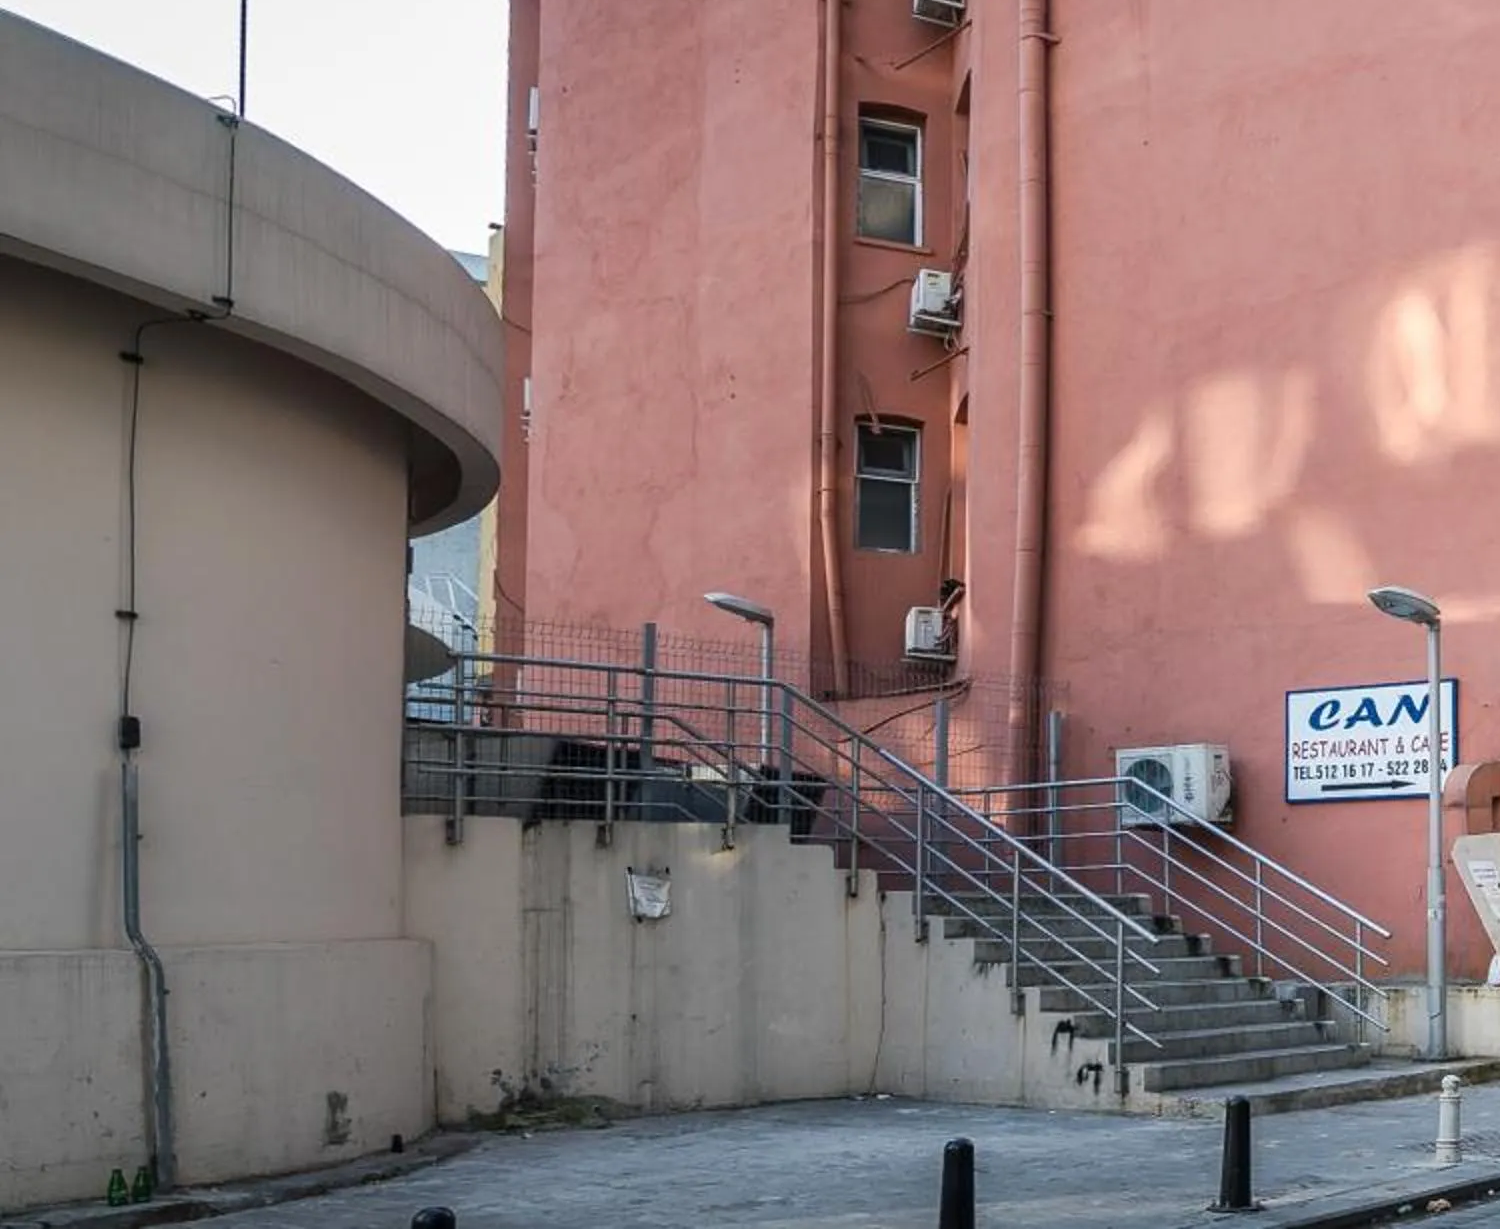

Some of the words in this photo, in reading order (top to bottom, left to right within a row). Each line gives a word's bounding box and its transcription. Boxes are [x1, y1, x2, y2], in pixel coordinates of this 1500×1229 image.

[1308, 694, 1431, 731] CAN
[1292, 738, 1389, 760] RESTAURANT
[1396, 738, 1405, 754] &
[1410, 731, 1449, 754] CAE
[1342, 764, 1355, 777] 16
[1360, 762, 1375, 777] 17
[1387, 761, 1409, 776] 522
[1413, 759, 1430, 773] 28
